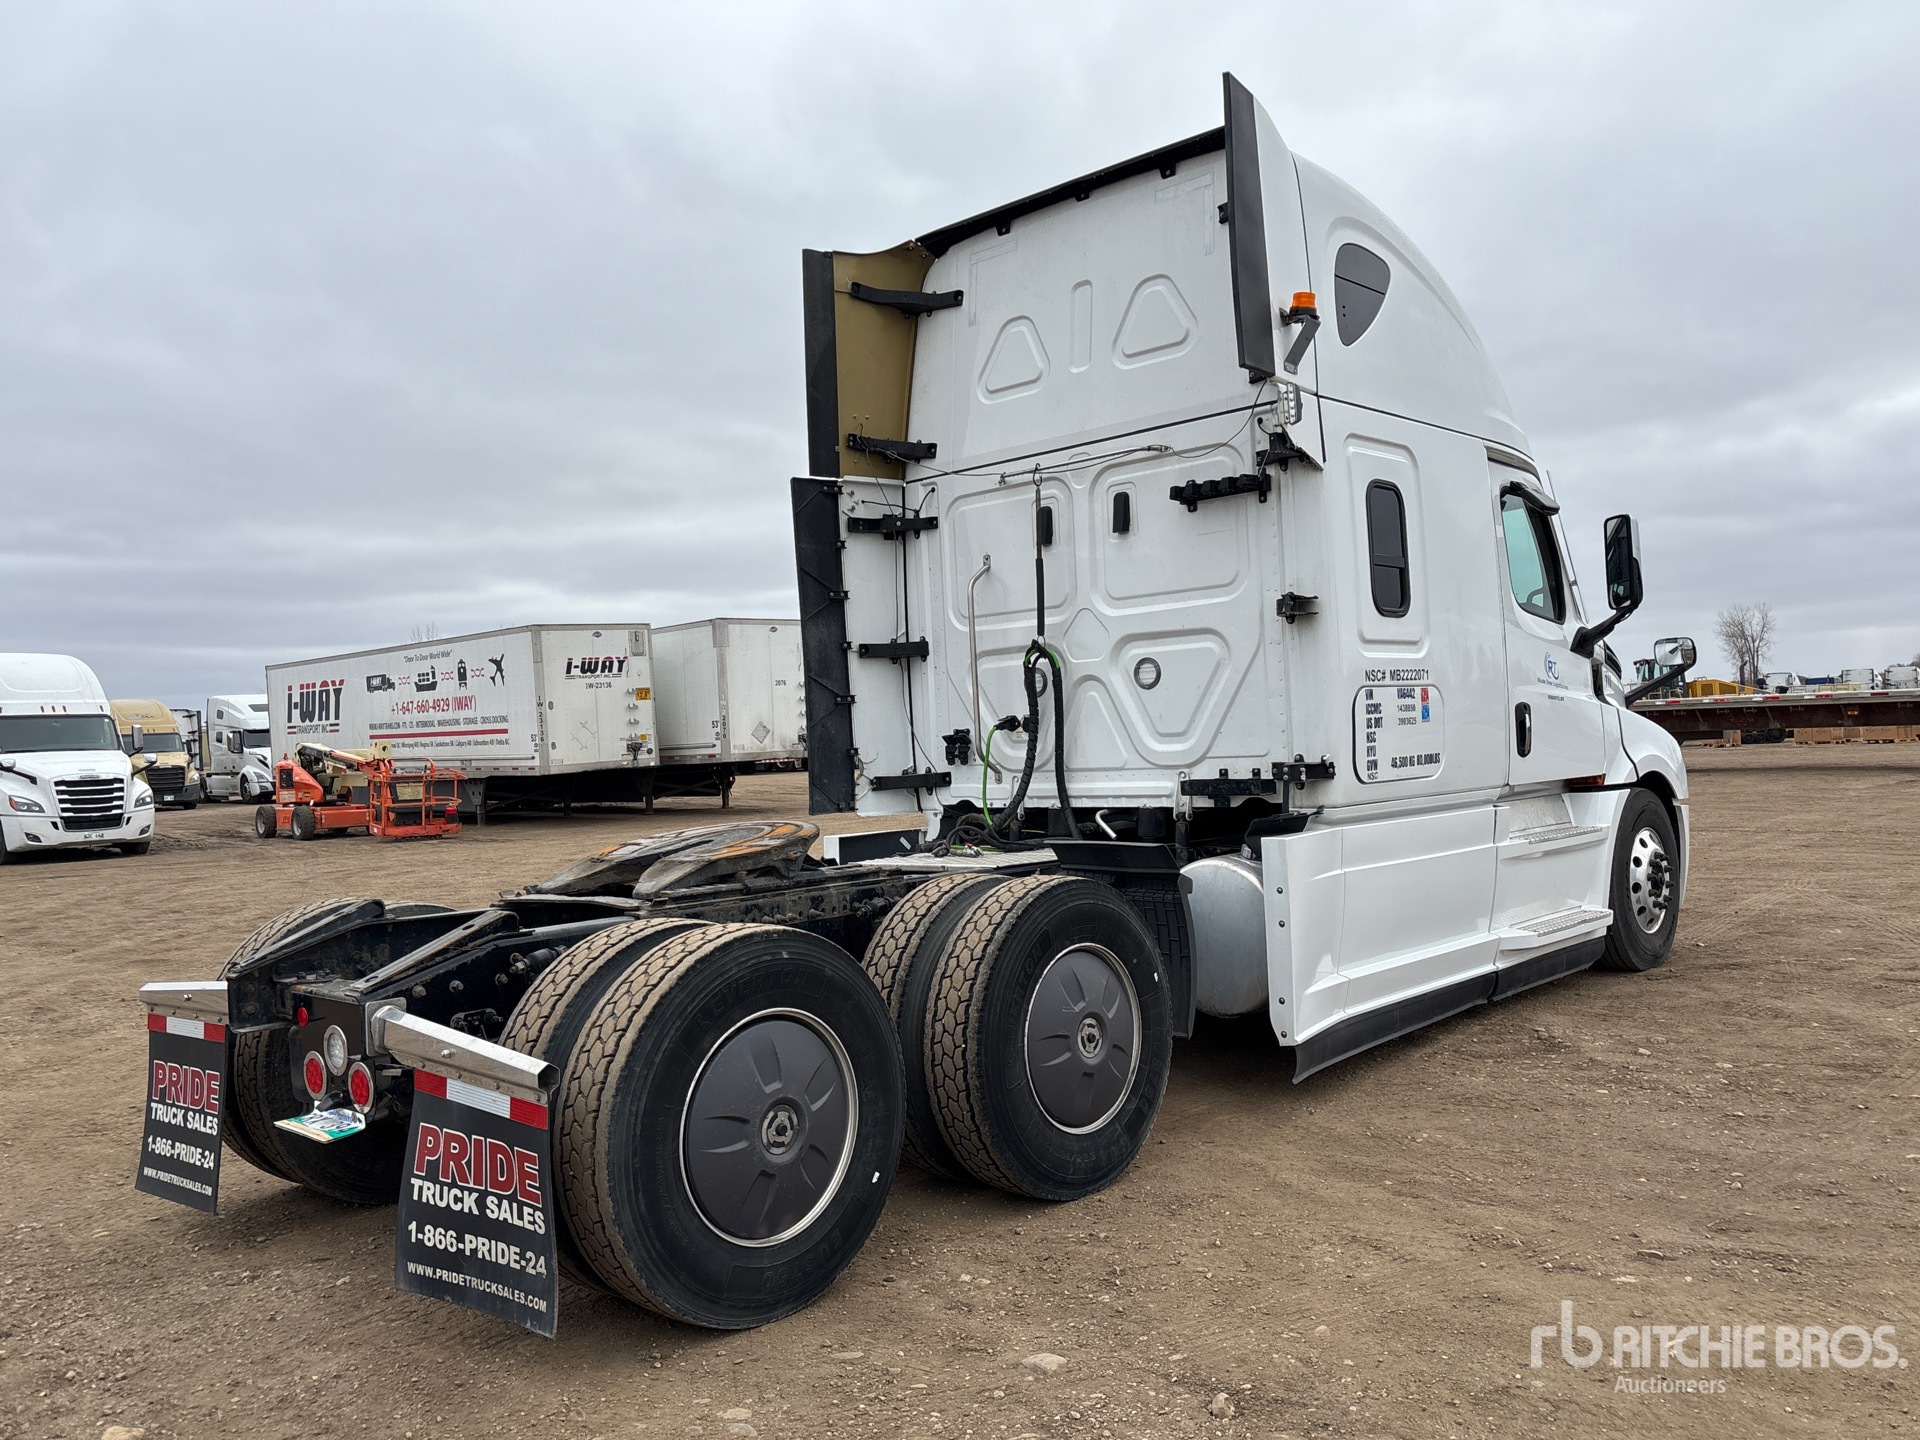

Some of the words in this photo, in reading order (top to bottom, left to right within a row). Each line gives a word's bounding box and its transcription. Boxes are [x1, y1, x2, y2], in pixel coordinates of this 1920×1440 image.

[1365, 669, 1386, 682] NSC#
[1389, 668, 1429, 682] MB2222071
[391, 697, 450, 716] +1-647-660-4929
[451, 694, 477, 714] (IWAY)
[297, 723, 321, 735] TRANSPORT
[152, 1059, 220, 1114] PRIDE
[150, 1102, 185, 1127] TRUCK
[187, 1110, 219, 1136] SALES
[147, 1134, 215, 1171] 1-866-PRIDE-24
[413, 1122, 542, 1207] PRIDE
[143, 1166, 213, 1197] WWW.PRIDETRUCKSALES.COM
[410, 1177, 480, 1216] TRUCK
[485, 1198, 546, 1235] SALES
[407, 1220, 547, 1279] 1-866-PRIDE-24
[407, 1261, 547, 1313] WWW.PRIDETRUCKSALES.COM
